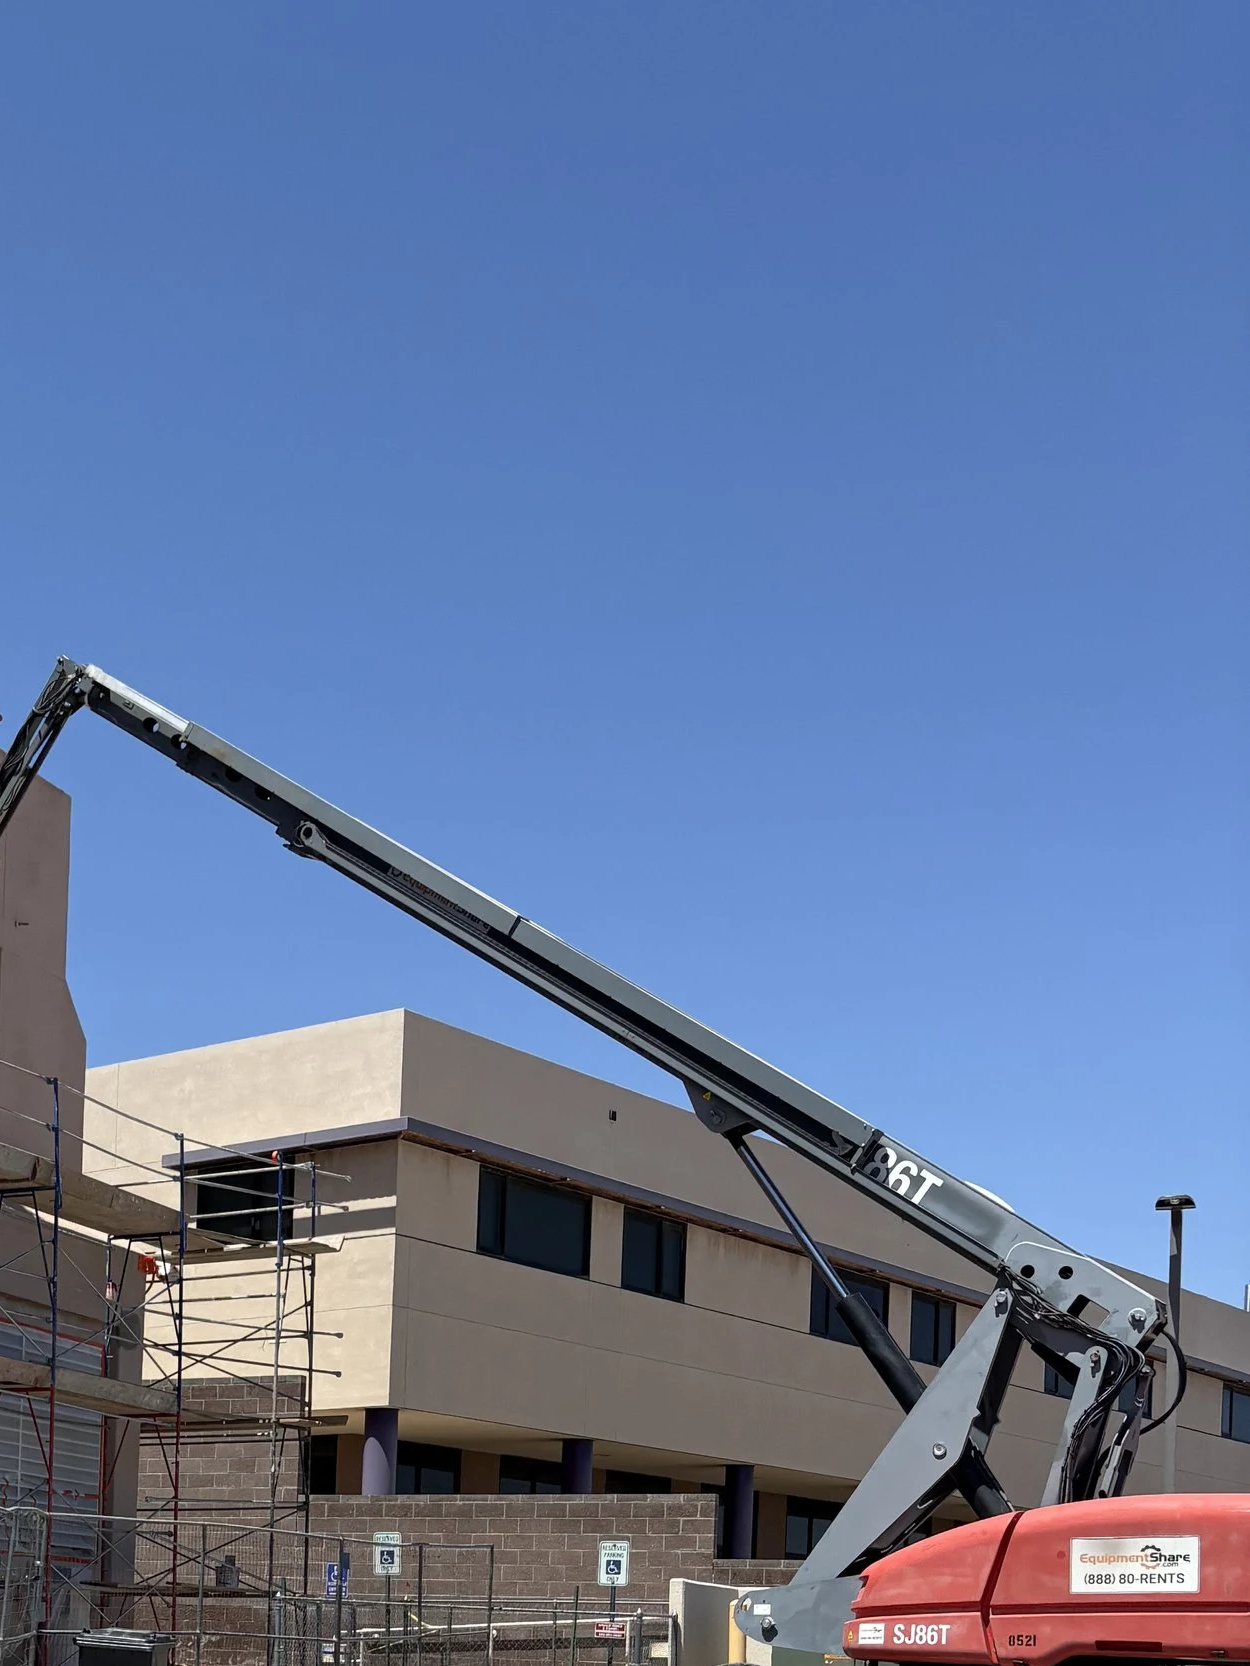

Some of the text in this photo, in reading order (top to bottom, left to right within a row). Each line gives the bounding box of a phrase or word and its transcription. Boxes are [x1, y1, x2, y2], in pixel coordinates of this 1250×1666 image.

[1080, 1552, 1190, 1565] EquipmentShare
[1084, 1573, 1185, 1585] (888) 80-RENTS
[893, 1623, 951, 1645] SJ86T
[1008, 1635, 1037, 1646] 8521
